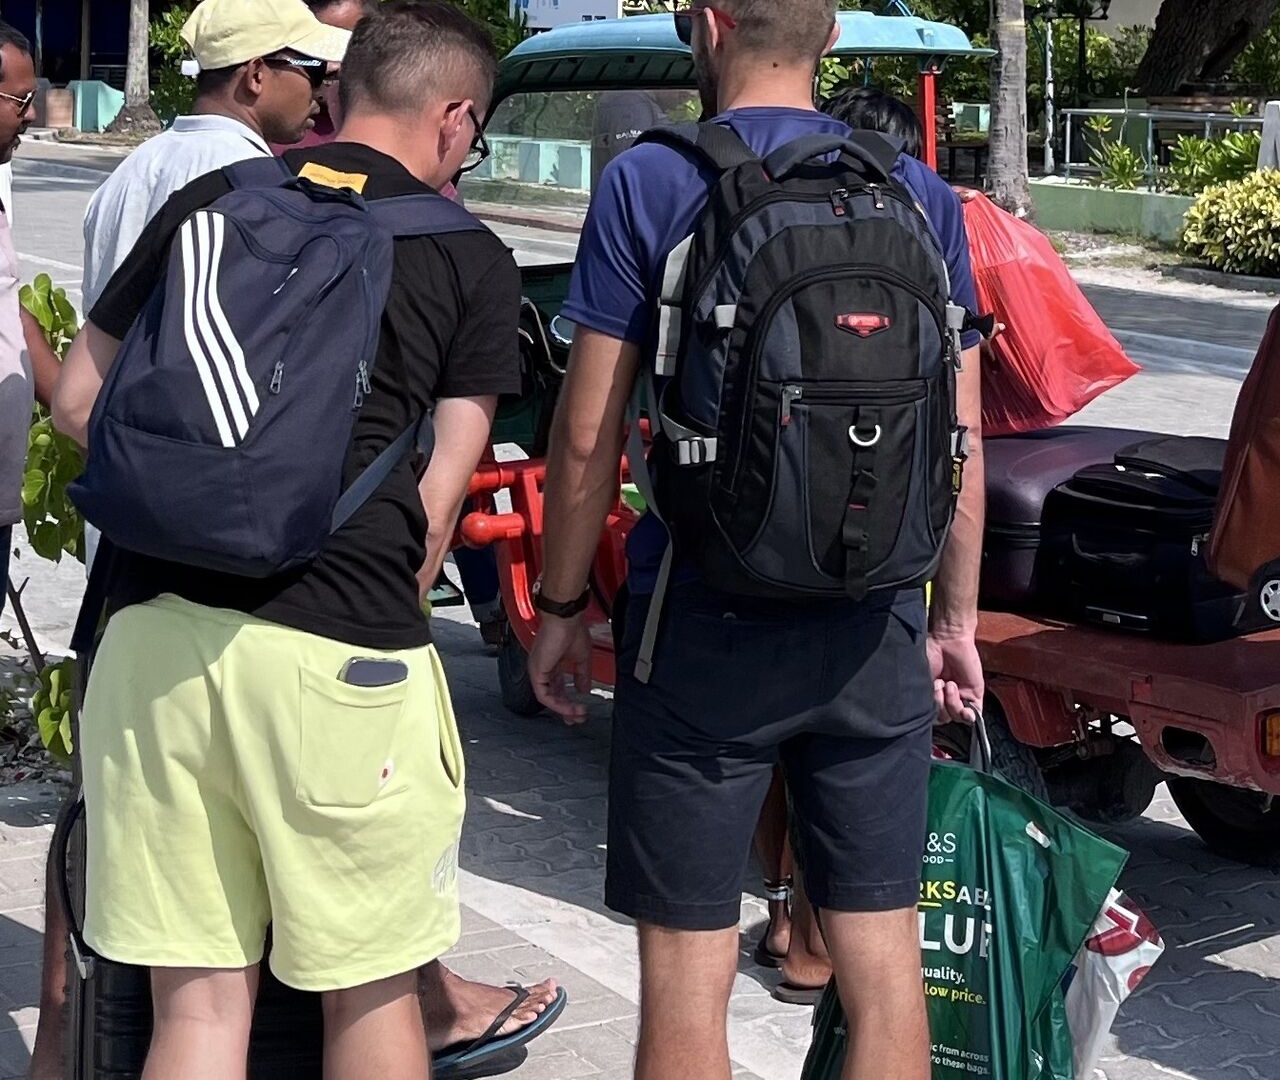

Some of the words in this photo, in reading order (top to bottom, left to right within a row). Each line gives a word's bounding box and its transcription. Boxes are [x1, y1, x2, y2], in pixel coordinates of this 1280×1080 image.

[926, 832, 956, 853] &S
[922, 855, 944, 864] OOD
[924, 982, 949, 998] low
[939, 1043, 960, 1057] from
